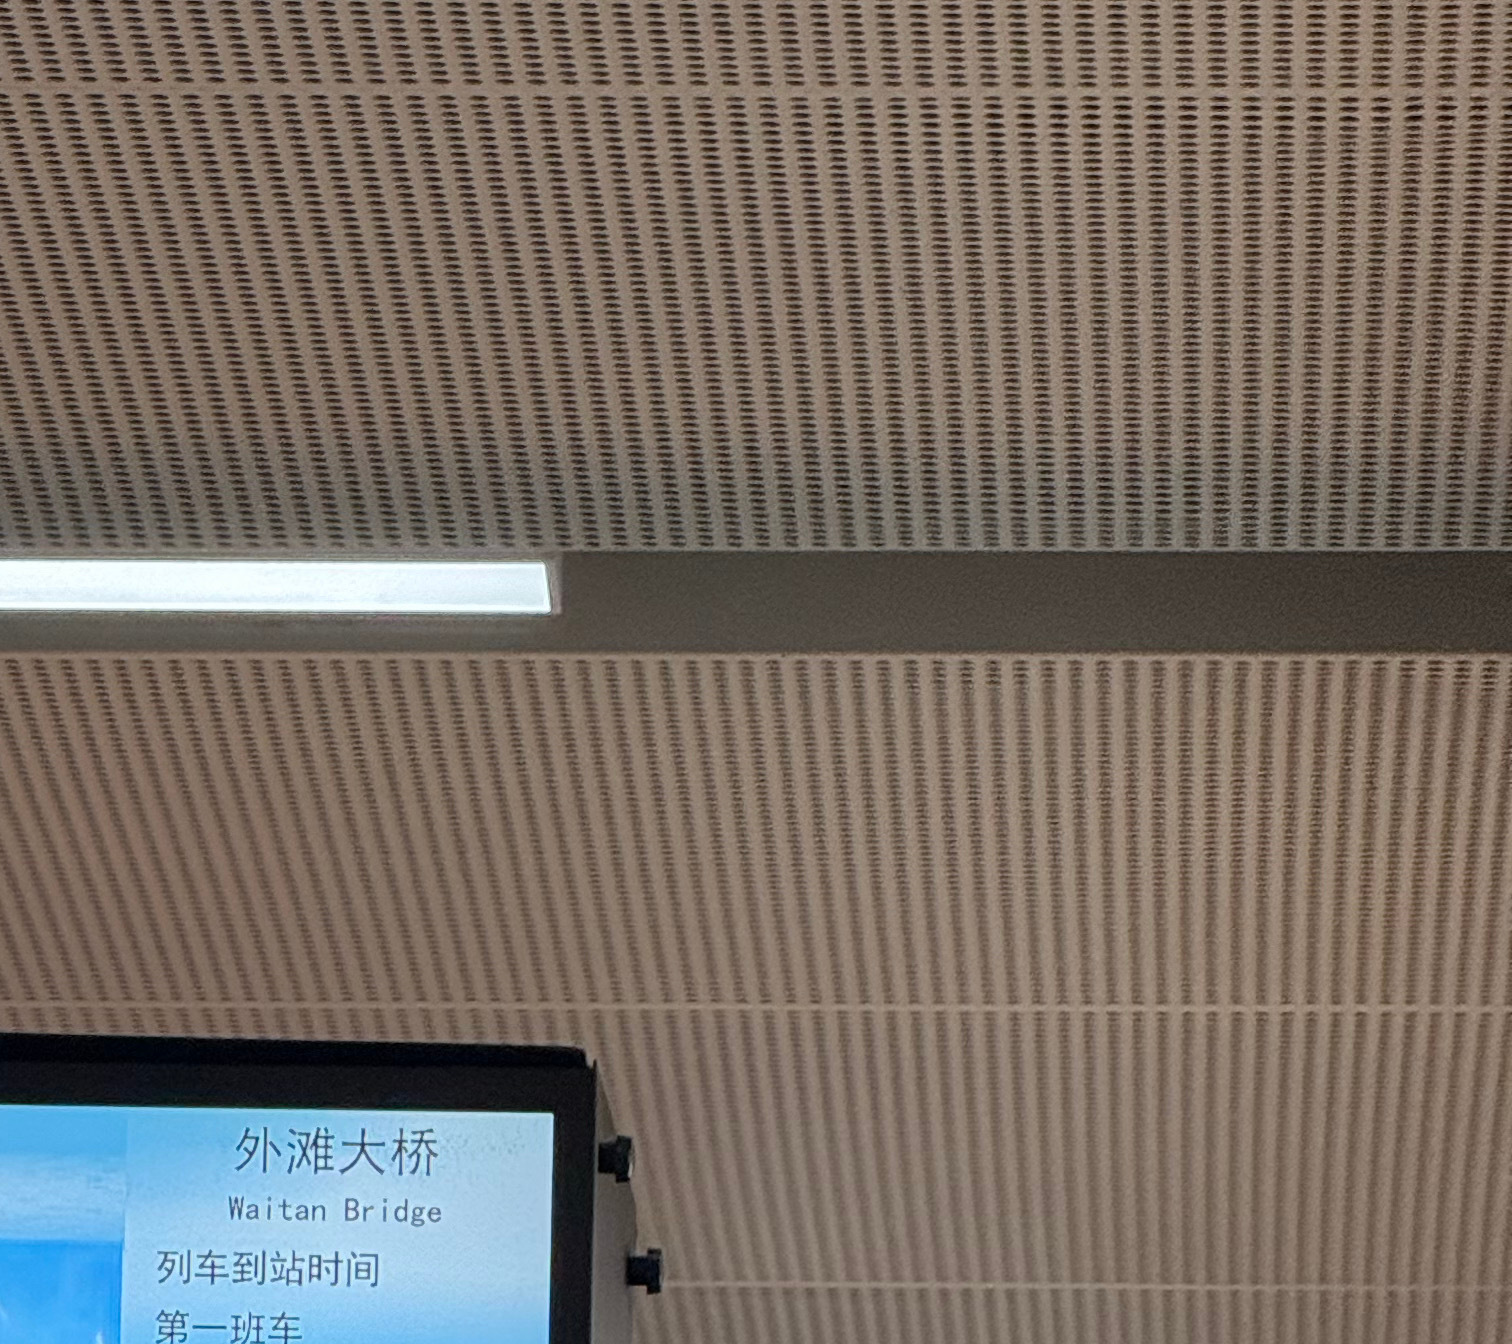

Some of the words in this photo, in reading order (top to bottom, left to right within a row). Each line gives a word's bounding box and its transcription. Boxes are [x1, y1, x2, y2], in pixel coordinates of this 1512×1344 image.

[234, 1126, 438, 1176] 外滩大桥
[229, 1196, 325, 1221] Waitan
[345, 1198, 441, 1227] Bridge
[157, 1249, 378, 1288] 列车到站时间
